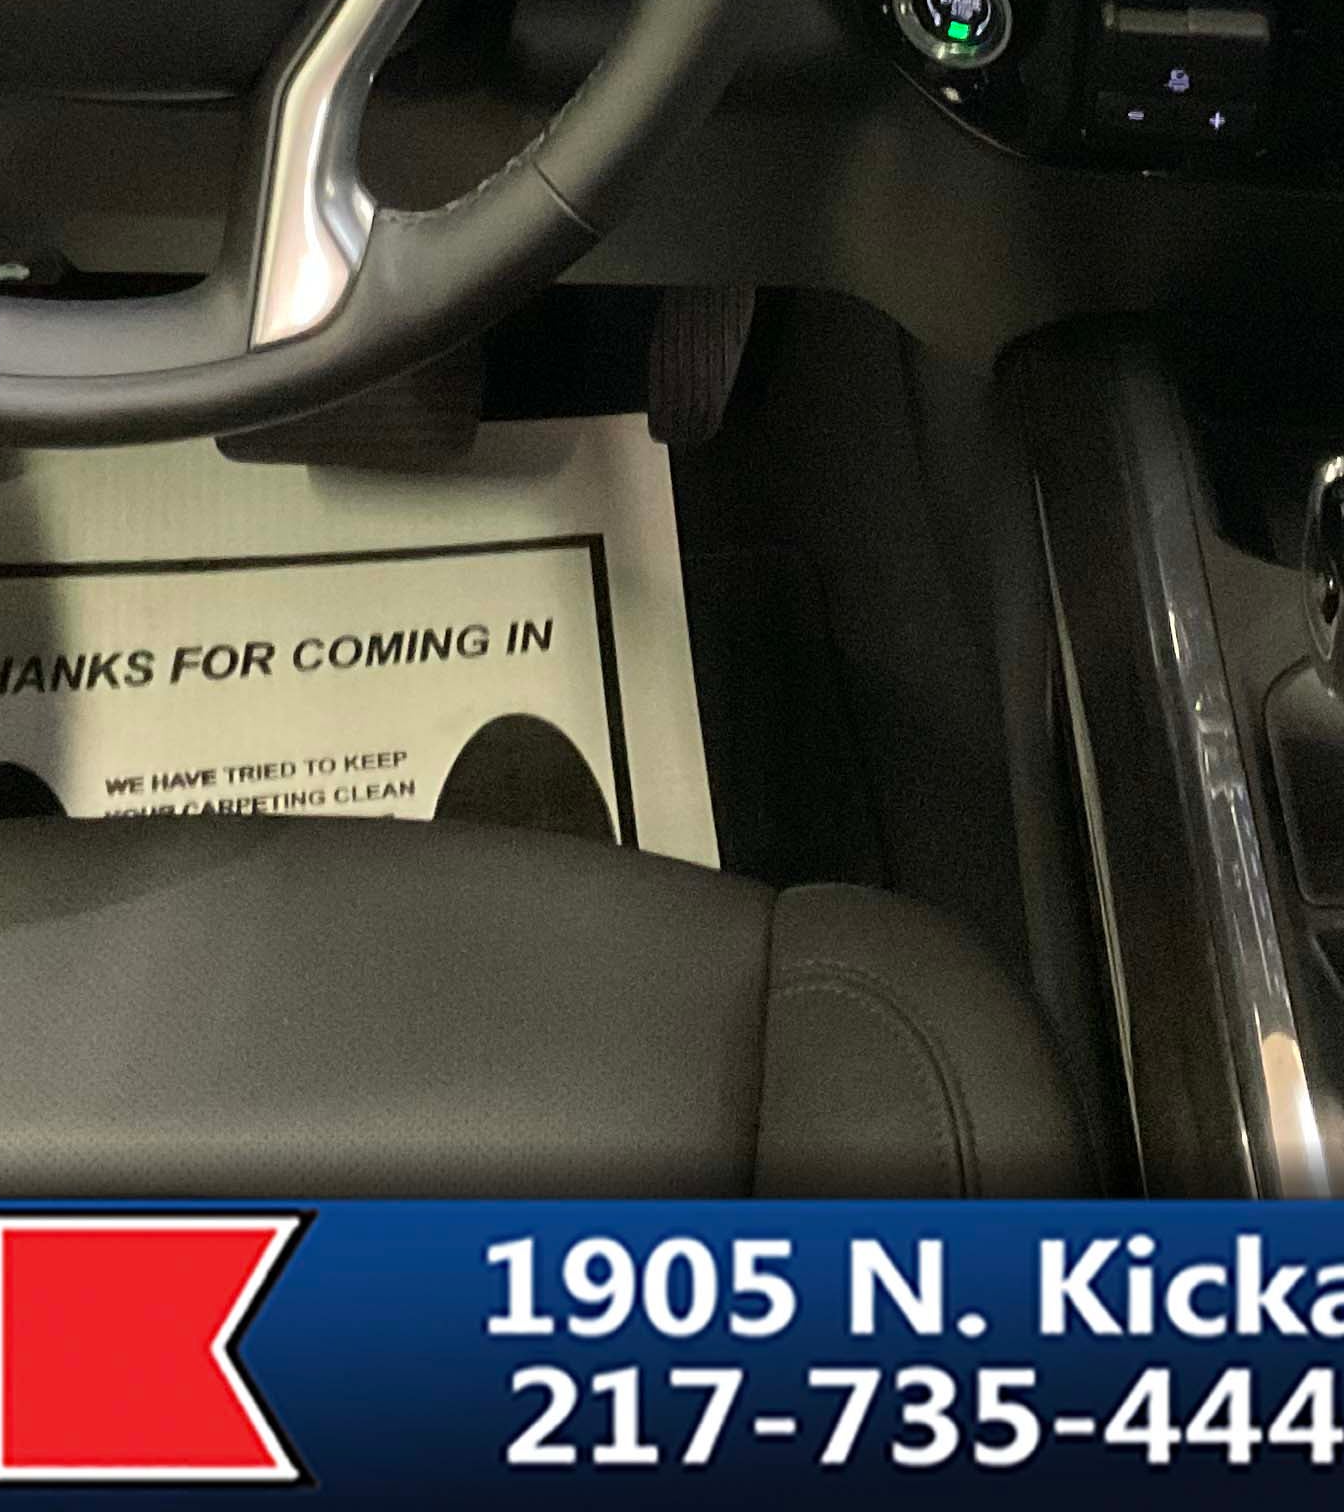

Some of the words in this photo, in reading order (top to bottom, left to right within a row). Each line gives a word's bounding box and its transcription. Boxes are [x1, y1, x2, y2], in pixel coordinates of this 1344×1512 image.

[169, 641, 276, 685] FOR
[291, 624, 492, 674] COMING
[506, 619, 554, 655] IN
[105, 776, 145, 797] WE
[151, 768, 217, 793] HAVE
[223, 760, 297, 785] TRIED
[303, 756, 337, 777] TO
[343, 750, 409, 773] KEEP
[181, 789, 326, 817] CARPETING
[333, 779, 416, 804] CLEAN
